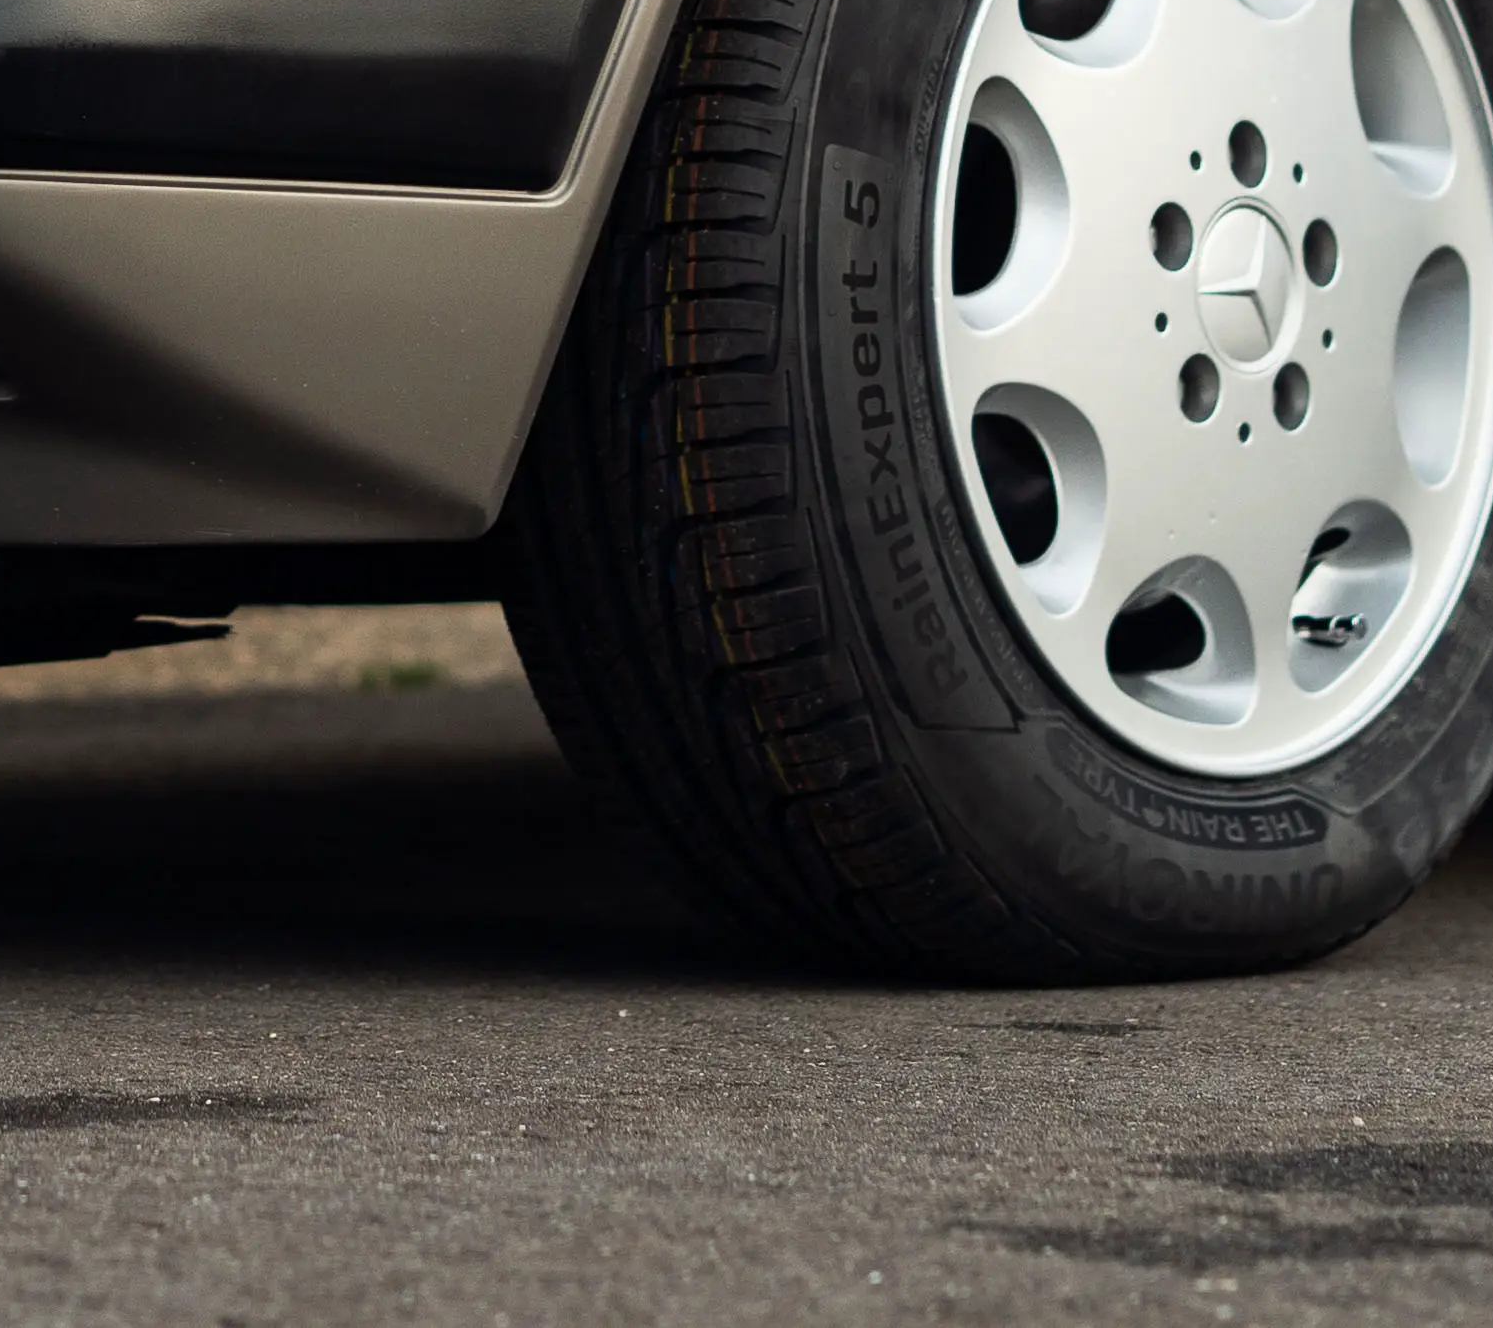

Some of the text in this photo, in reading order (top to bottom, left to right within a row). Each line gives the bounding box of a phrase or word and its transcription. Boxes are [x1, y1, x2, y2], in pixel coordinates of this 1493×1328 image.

[843, 178, 880, 230] 5
[841, 259, 969, 702] RainExpert
[1063, 744, 1316, 843] THE RAIN TYRE
